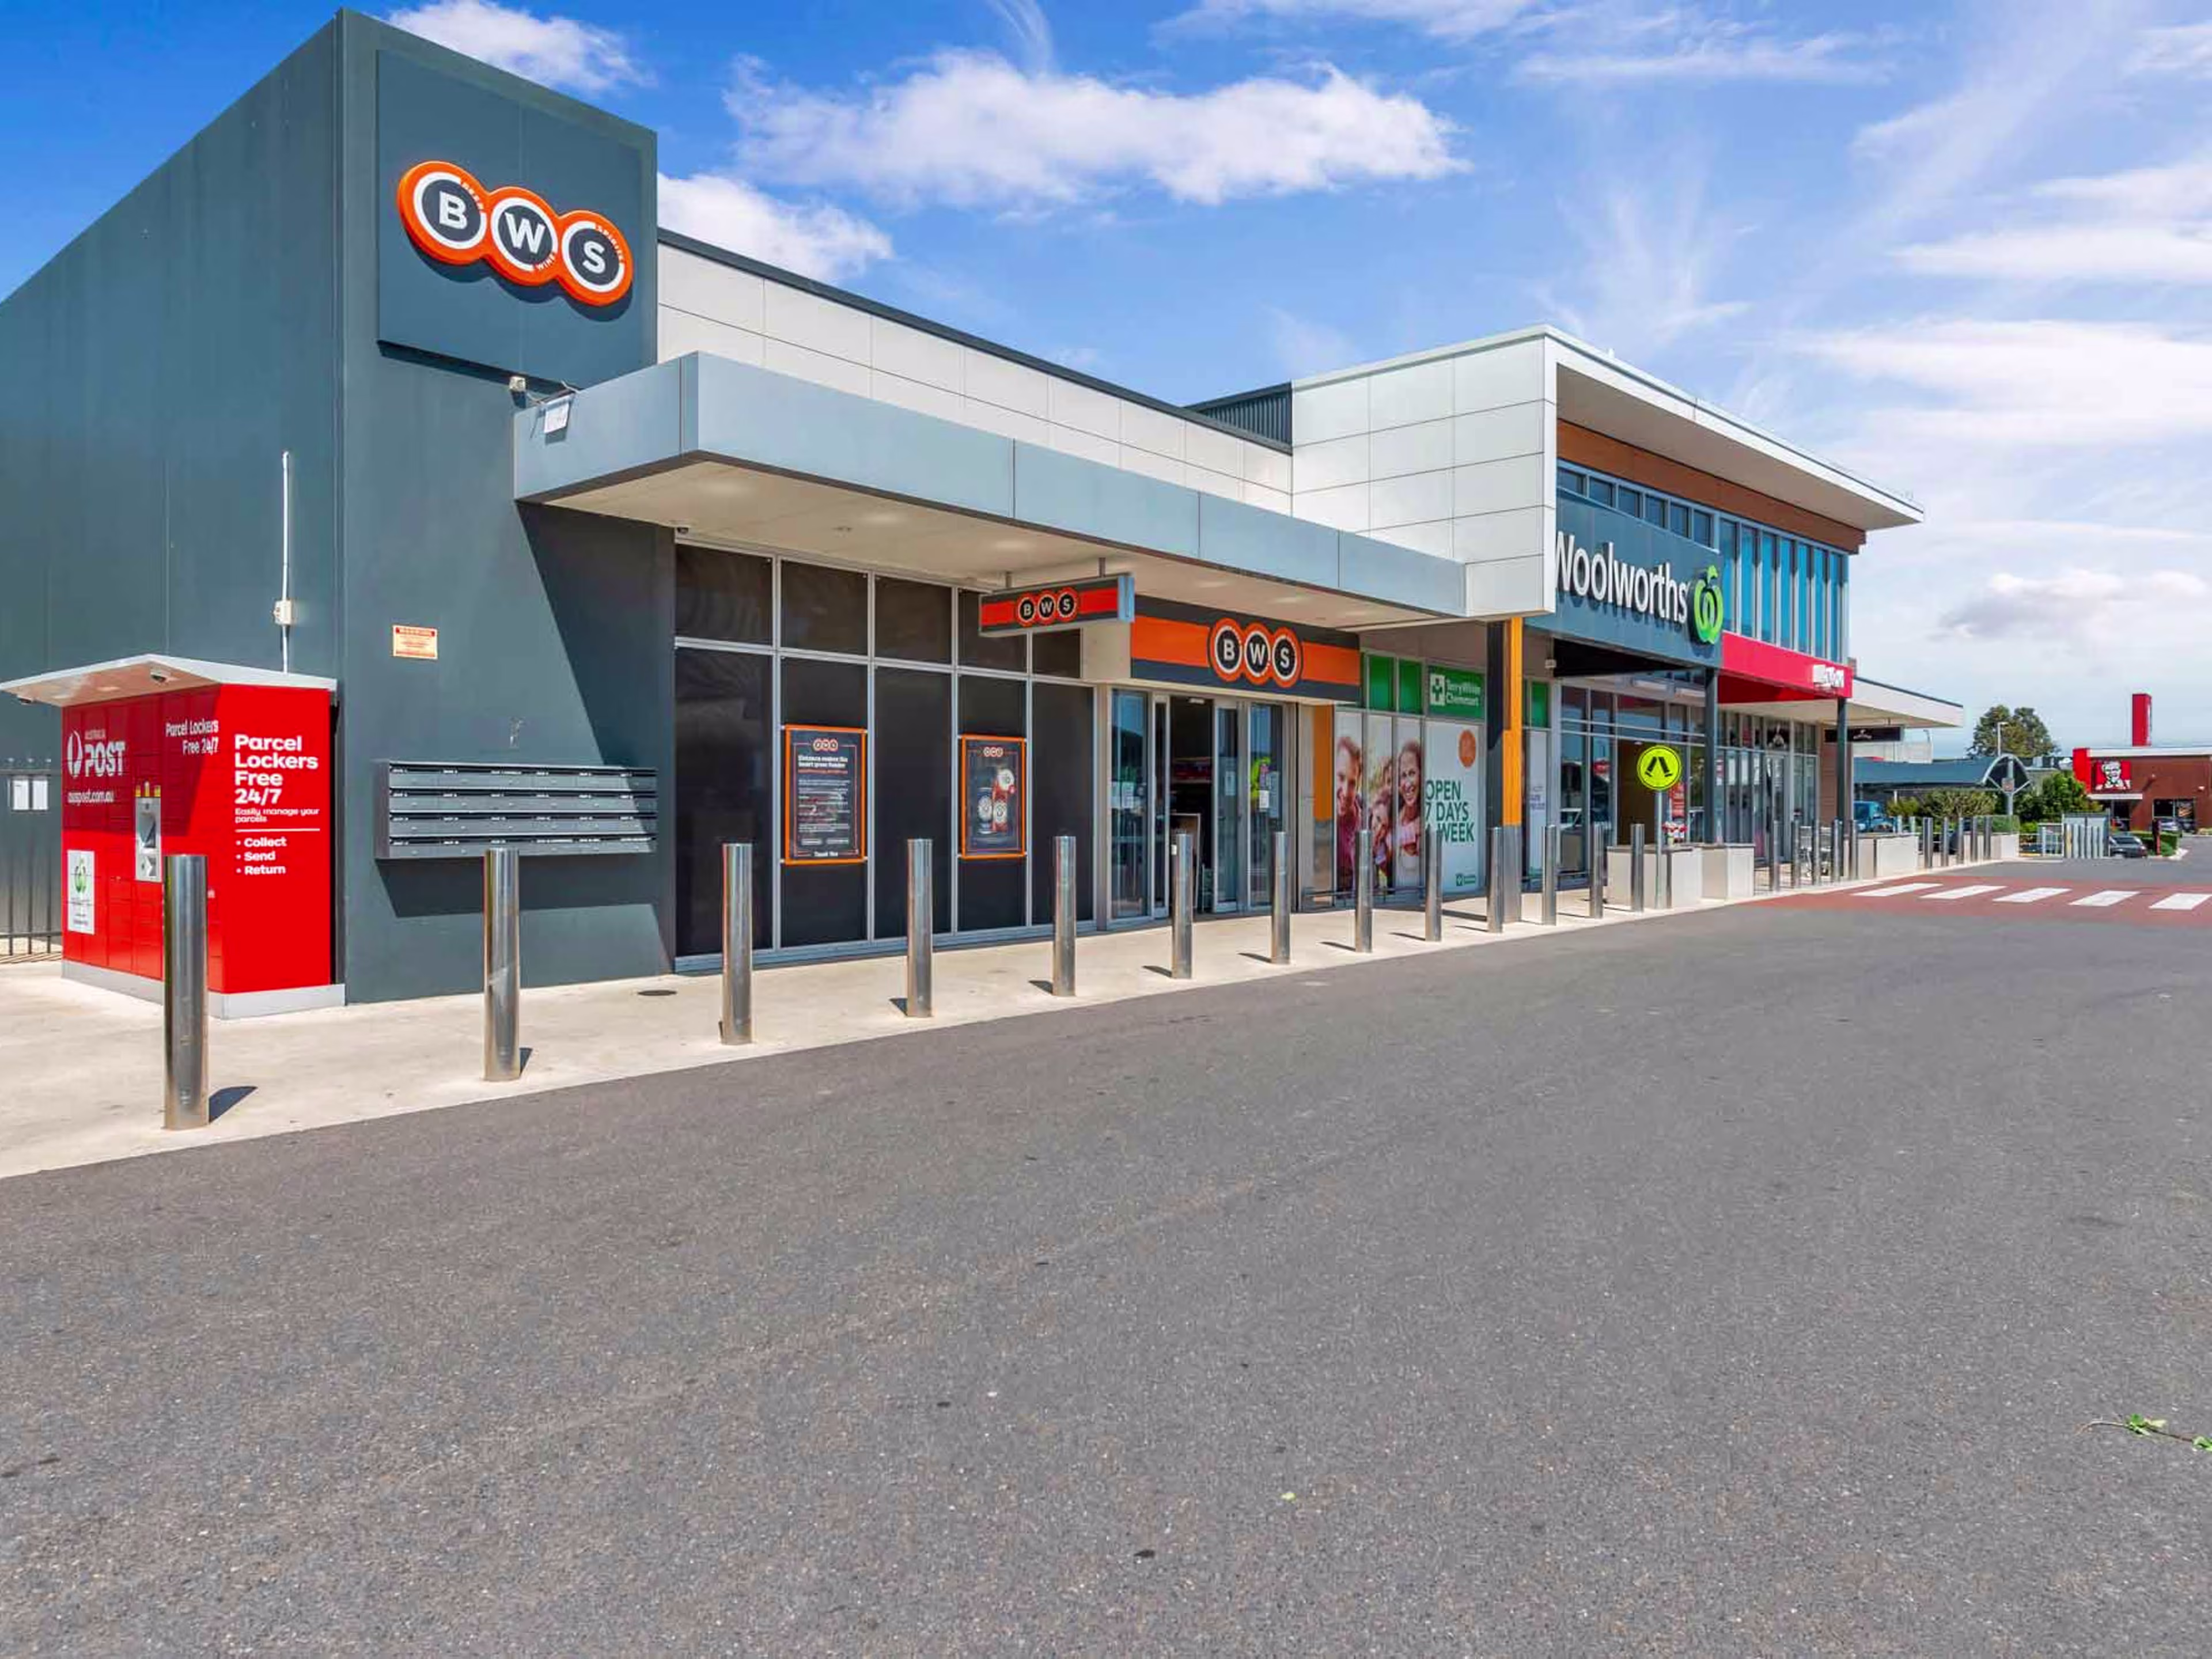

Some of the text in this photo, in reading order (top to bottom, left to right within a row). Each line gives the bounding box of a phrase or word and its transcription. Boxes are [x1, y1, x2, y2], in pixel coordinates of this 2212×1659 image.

[440, 191, 605, 274] BWS
[1555, 531, 1688, 624] Woolworths
[1023, 598, 1070, 616] BWS
[1224, 639, 1290, 668] BWS
[165, 718, 219, 737] Parcel Lockers
[183, 740, 199, 756] Free
[234, 733, 302, 752] Parcel
[84, 741, 126, 777] POST
[234, 752, 319, 770] Lockers
[234, 770, 283, 787] Free
[234, 787, 282, 806] 24/7
[1426, 779, 1461, 800] OPEN
[263, 808, 299, 816] manage
[300, 808, 320, 816] your
[1426, 801, 1469, 821] 7 DAYS
[244, 836, 287, 847] Collect
[1438, 823, 1475, 842] WEEK
[244, 850, 276, 861] Send
[244, 865, 286, 875] Return
